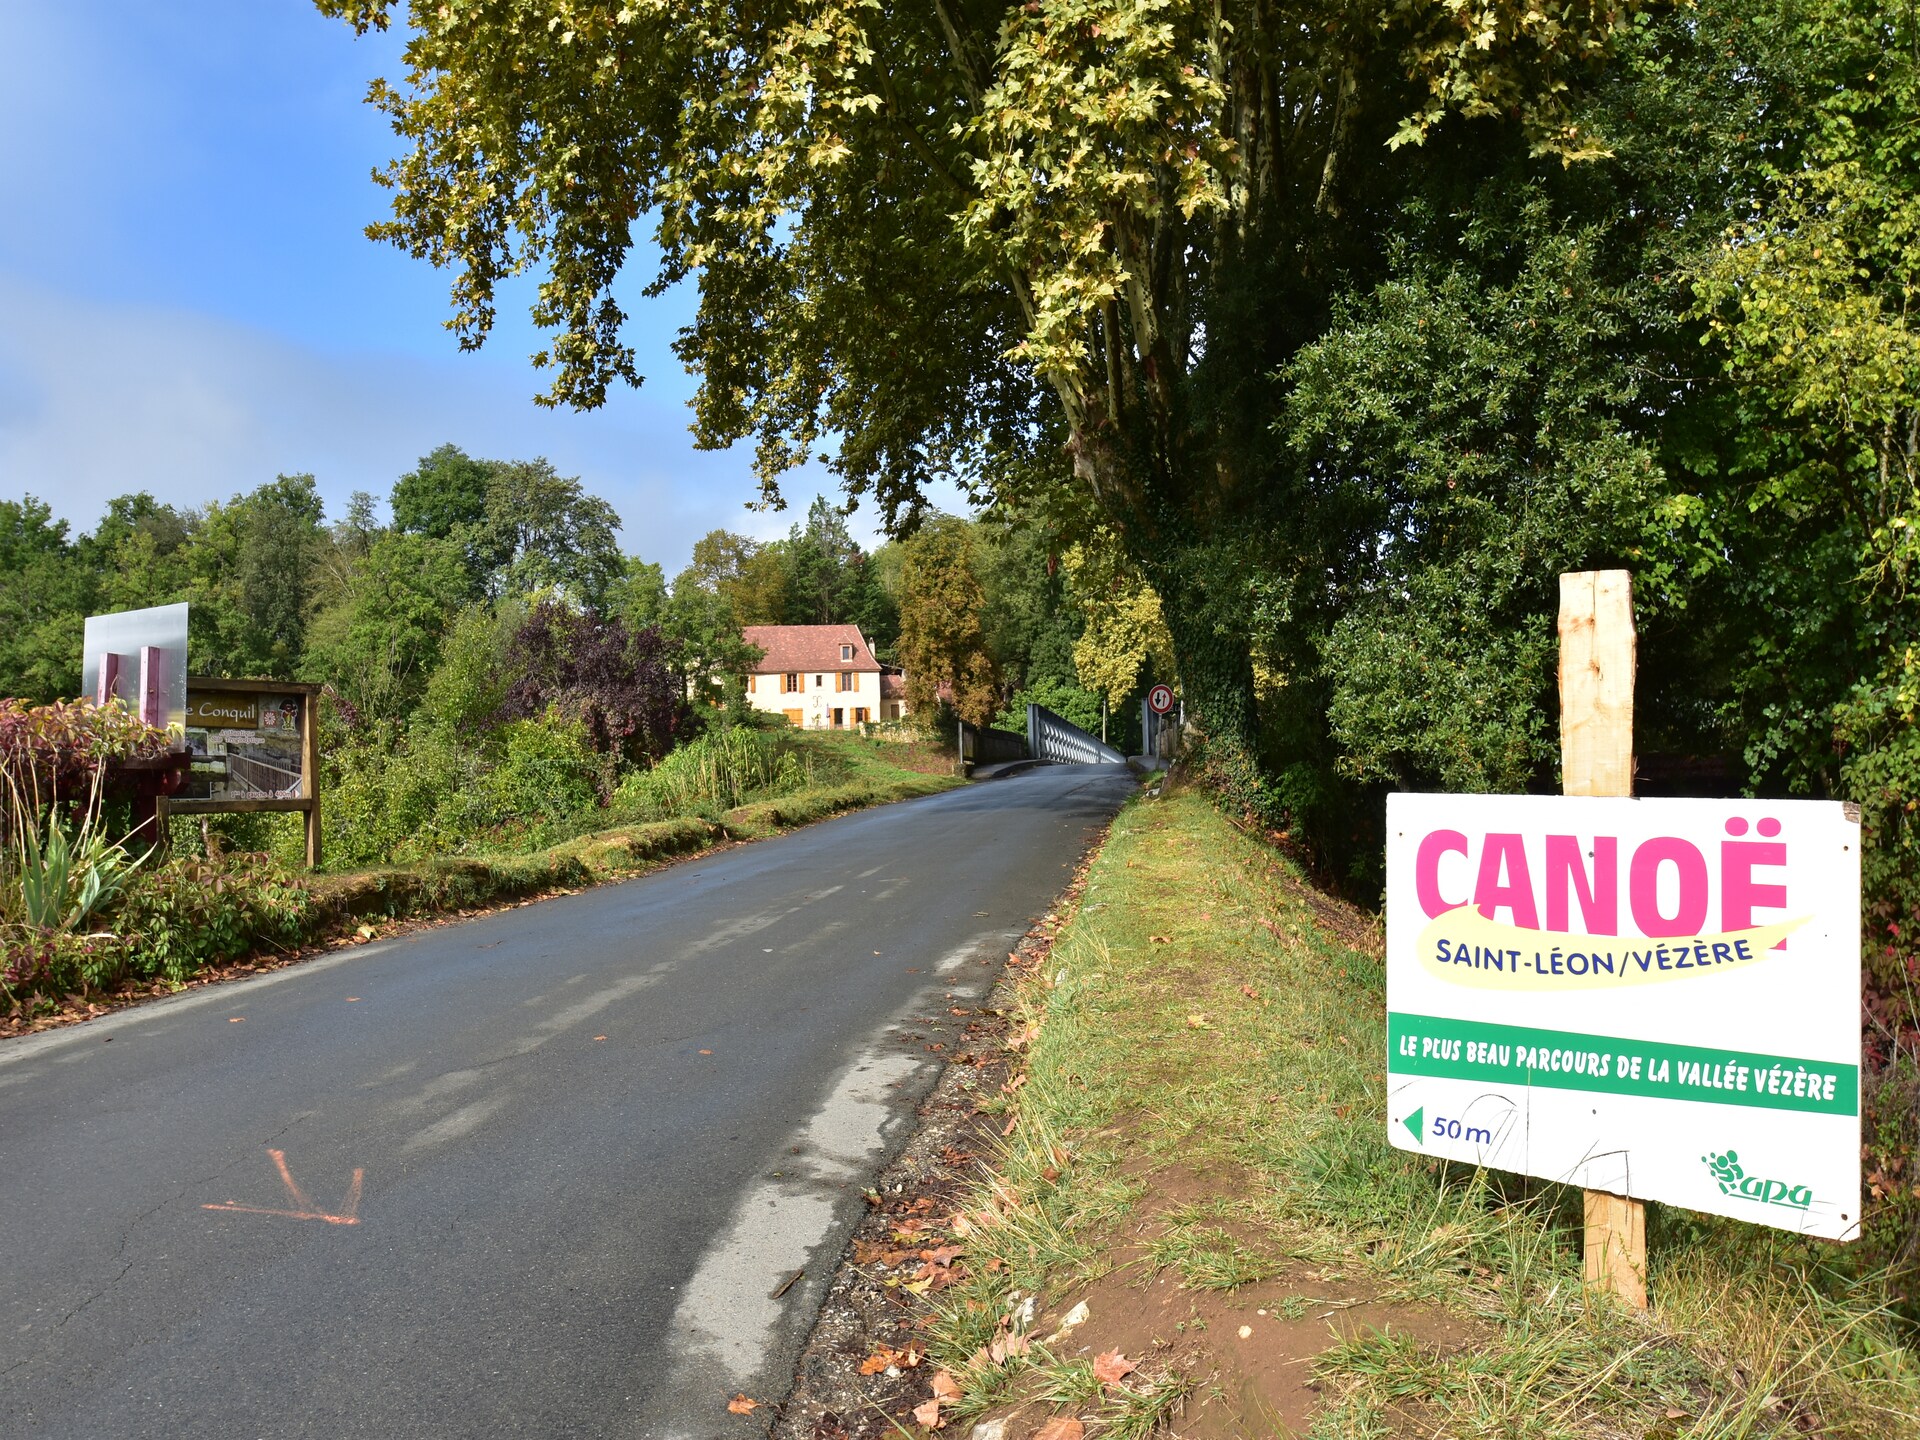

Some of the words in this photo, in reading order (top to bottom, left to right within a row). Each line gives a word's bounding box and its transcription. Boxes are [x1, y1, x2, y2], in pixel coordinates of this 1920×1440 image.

[199, 702, 254, 722] Conquil
[1416, 816, 1786, 951] CANOË
[1399, 1035, 1417, 1057] LE
[1422, 1037, 1462, 1061] PLUS
[1466, 1041, 1510, 1067] BEAU
[1516, 1046, 1611, 1077] PARCOURS
[1616, 1055, 1642, 1080] DE
[1648, 1058, 1669, 1083] LA
[1677, 1059, 1749, 1091] VALLÉE
[1754, 1063, 1837, 1101] VÉZÈRE
